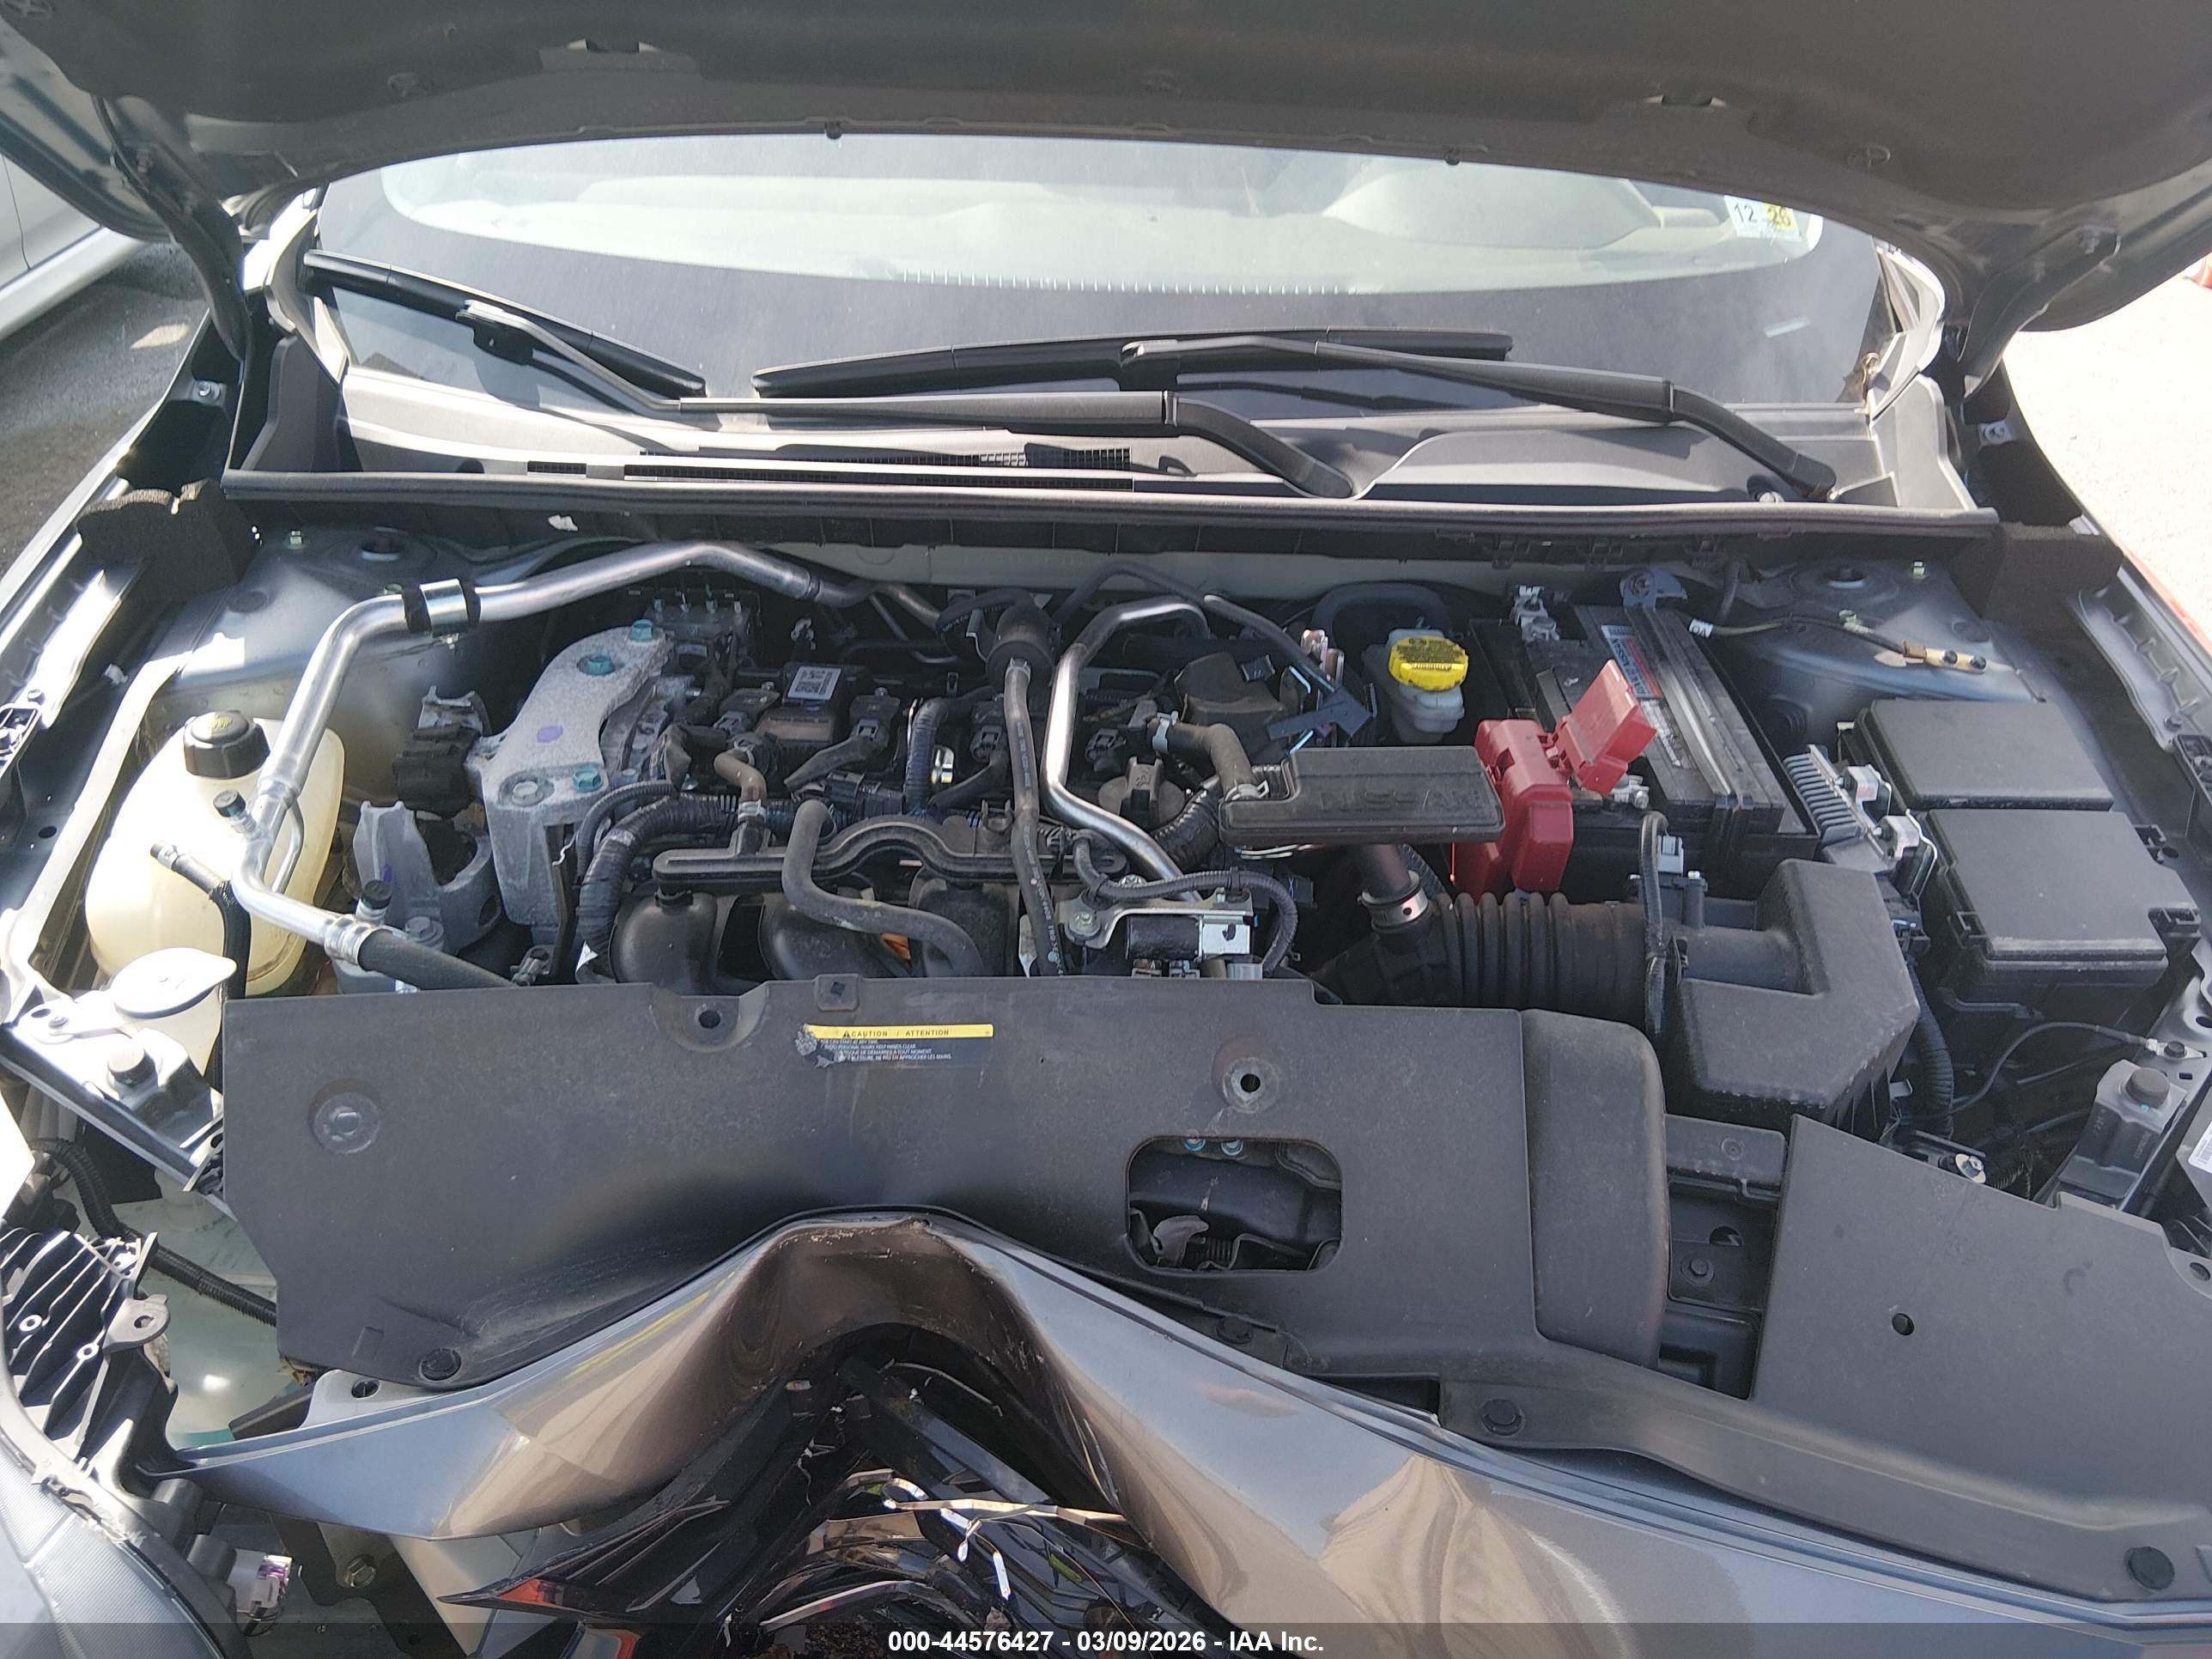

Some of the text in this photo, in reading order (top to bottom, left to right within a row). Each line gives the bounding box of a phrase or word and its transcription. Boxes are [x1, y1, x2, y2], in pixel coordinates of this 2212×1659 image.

[1734, 203, 1757, 223] 12
[851, 1030, 888, 1038] CAUTION
[906, 1029, 949, 1037] ATTENTION
